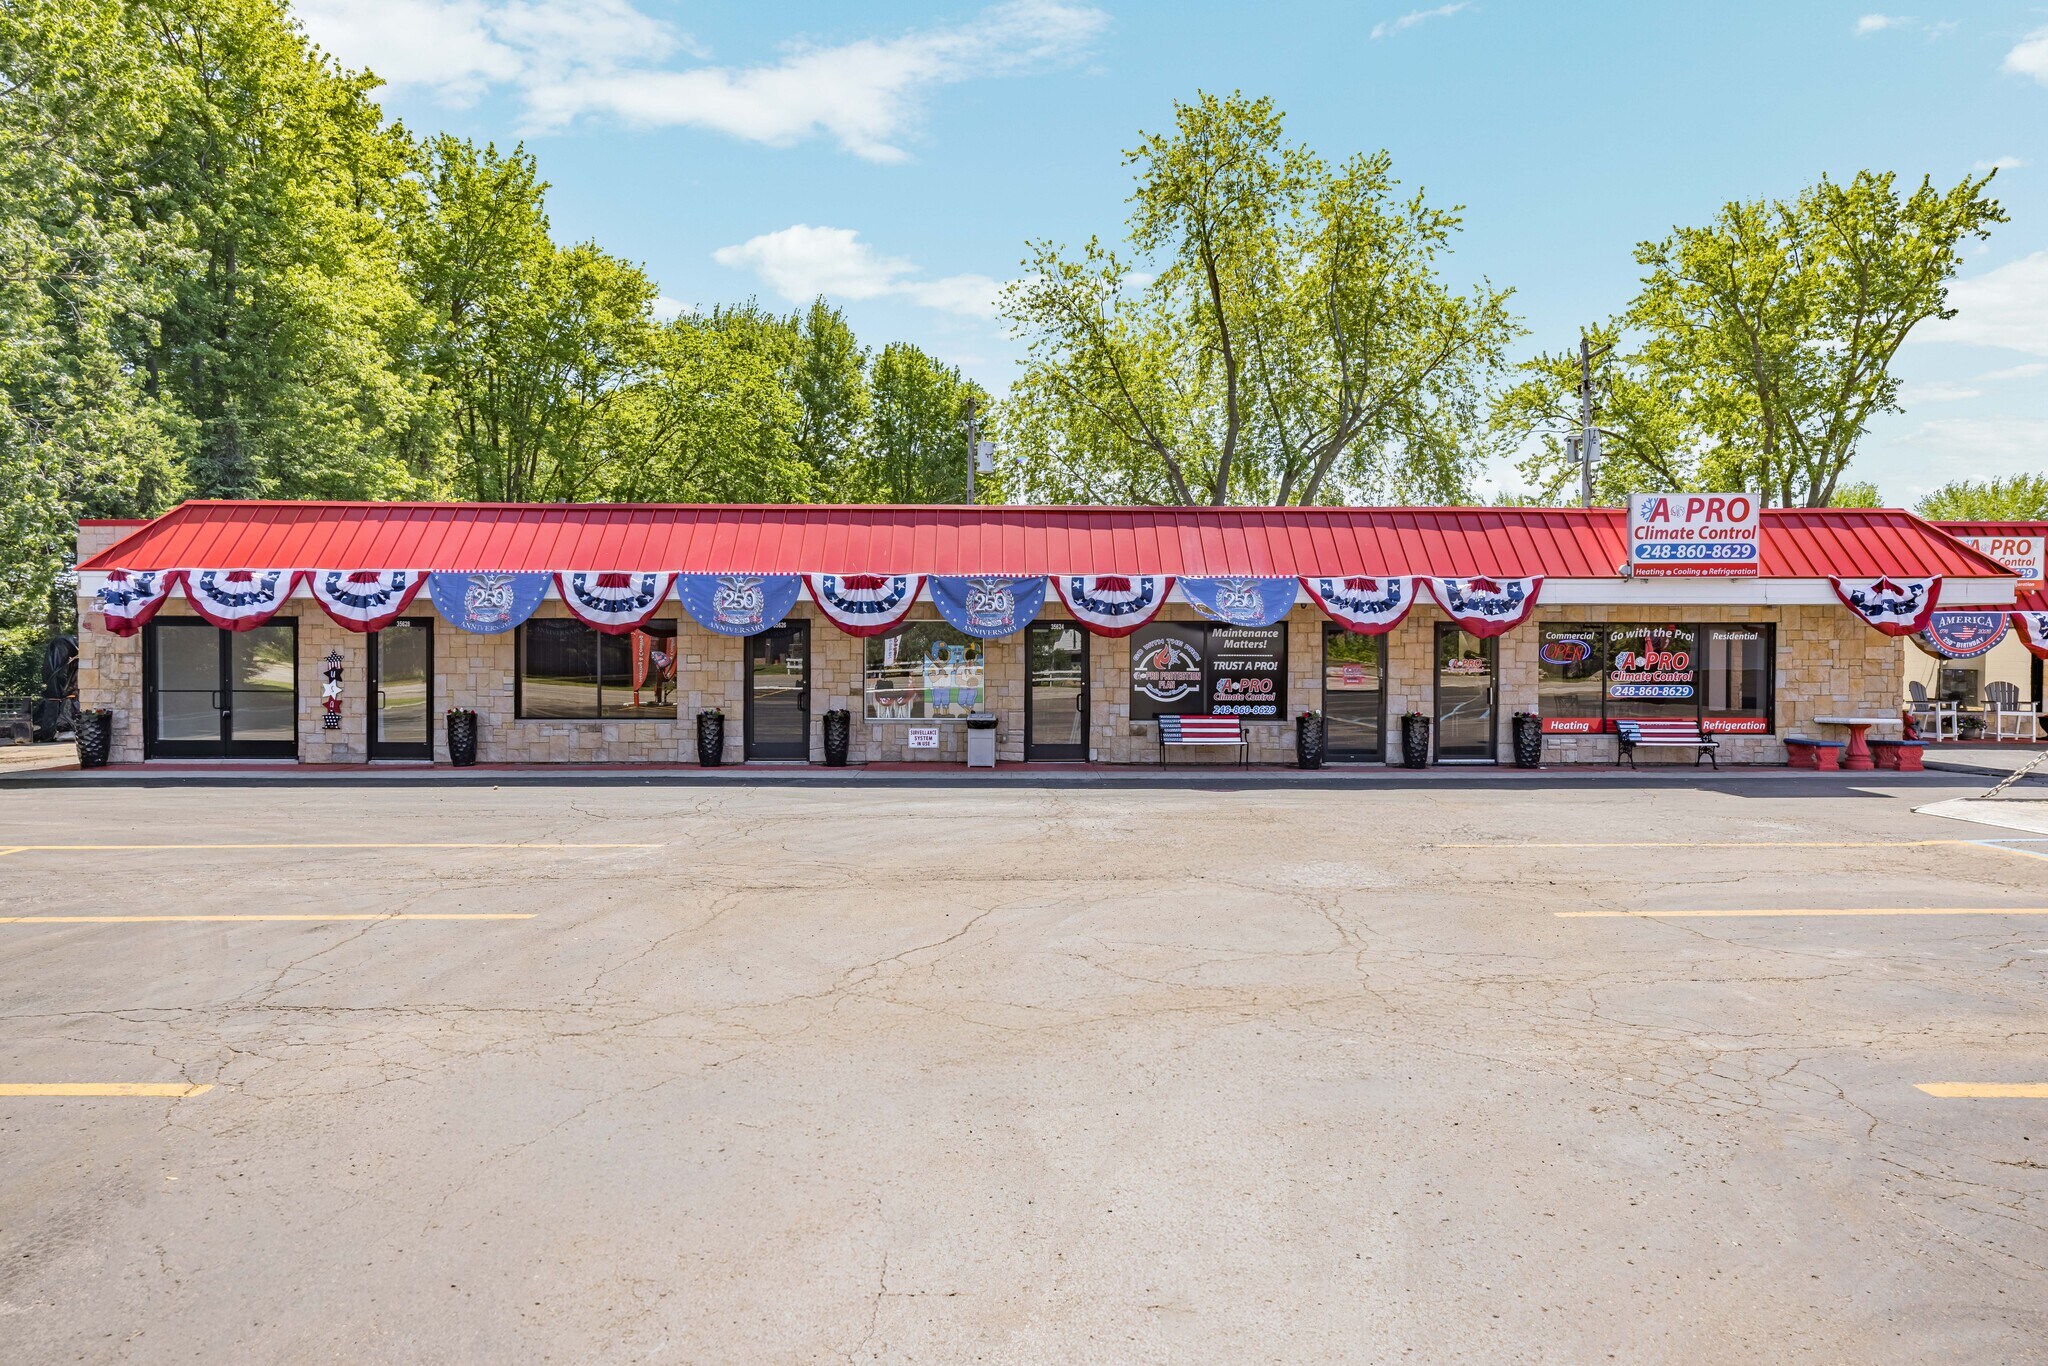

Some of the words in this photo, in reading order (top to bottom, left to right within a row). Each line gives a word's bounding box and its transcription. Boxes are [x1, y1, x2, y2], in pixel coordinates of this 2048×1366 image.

[1649, 497, 1670, 522] A
[1685, 497, 1750, 522] PRO
[1634, 525, 1694, 540] Climate
[1699, 525, 1756, 540] Control
[1641, 545, 1751, 558] 248-860-8629
[1990, 539, 2032, 555] PRO
[1999, 557, 2036, 566] Control
[1636, 568, 1664, 576] Heating
[1673, 568, 1701, 576] Cooling
[1709, 567, 1756, 576] Refrigeration
[474, 589, 504, 607] 250
[723, 591, 755, 609] 250
[975, 593, 1006, 611] 250
[1225, 593, 1256, 607] 250
[708, 621, 765, 633] ANNIVERSARY
[1938, 616, 1994, 628] AMERICA
[963, 624, 1017, 635] ANNIVERSARY
[1212, 628, 1279, 638] Maintenance
[1610, 631, 1624, 642] Go
[1625, 627, 1650, 639] with
[1653, 628, 1672, 638] the
[1675, 629, 1695, 642] Pro!
[1546, 631, 1595, 640] Commercial
[1713, 632, 1758, 640] Residential
[1223, 639, 1267, 649] Matters!
[1956, 636, 1984, 649] BIRTHDAY
[1545, 642, 1584, 661] OPEN
[1213, 661, 1244, 671] TRUST
[1245, 661, 1253, 671] A
[1254, 661, 1278, 671] PRO!
[1462, 659, 1483, 667] PRO
[1622, 652, 1635, 670] A
[1645, 651, 1690, 670] PRO
[1160, 671, 1201, 681] PROTECTION
[1610, 670, 1652, 682] Climate
[1653, 670, 1694, 682] Control
[1158, 680, 1176, 689] PLAN
[1221, 678, 1232, 692] A
[1238, 678, 1273, 693] PRO
[1614, 686, 1690, 696] 248-860-8629
[1213, 692, 1244, 702] Climate
[1244, 692, 1276, 702] Control
[1213, 705, 1277, 715] 248-860-8629
[1551, 720, 1590, 731] Heating
[1703, 720, 1766, 731] Refrigeration
